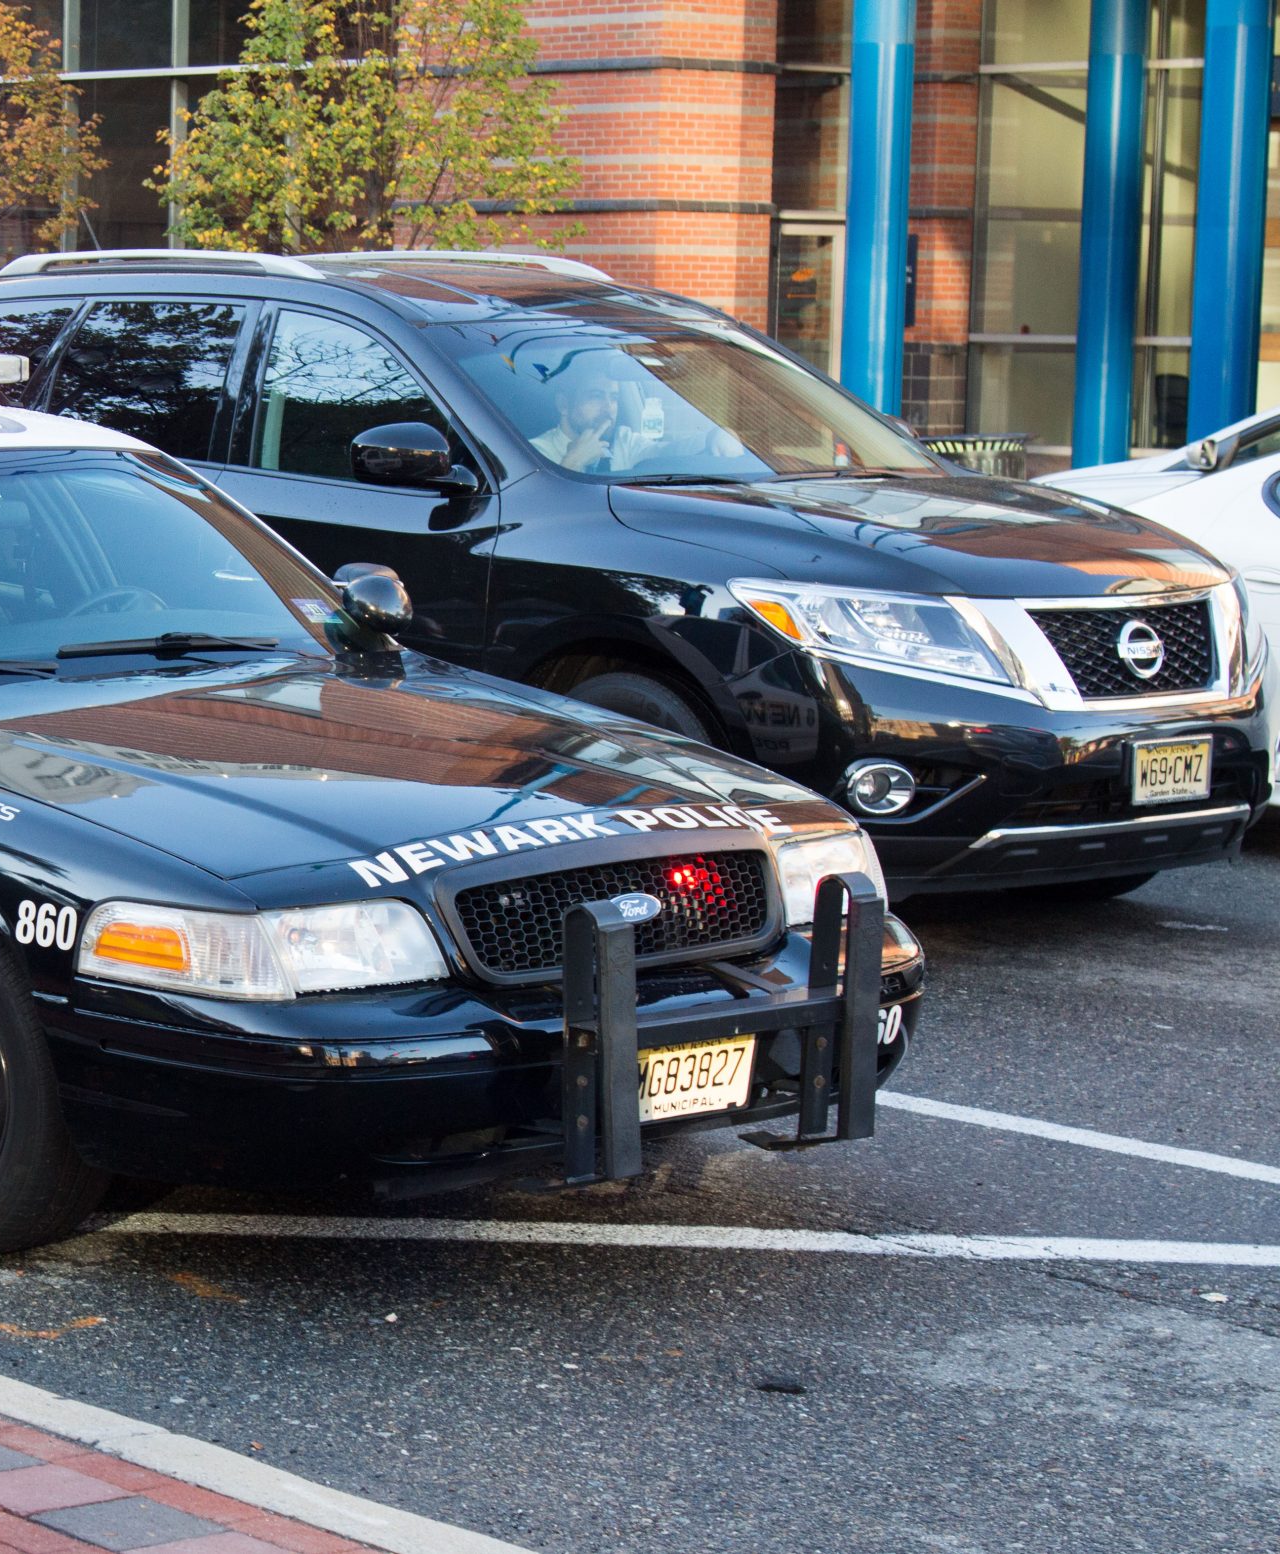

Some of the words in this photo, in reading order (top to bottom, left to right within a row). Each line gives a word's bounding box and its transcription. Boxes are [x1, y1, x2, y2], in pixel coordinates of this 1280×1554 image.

[1127, 645, 1162, 656] NISSAN
[1150, 789, 1170, 798] Garden
[1172, 787, 1188, 795] State
[347, 813, 620, 888] NEWARK
[616, 805, 794, 834] POLICE
[619, 899, 649, 918] Ford
[15, 899, 78, 951] 860
[877, 1004, 902, 1045] 60
[653, 1098, 715, 1114] MUNICIPAL
